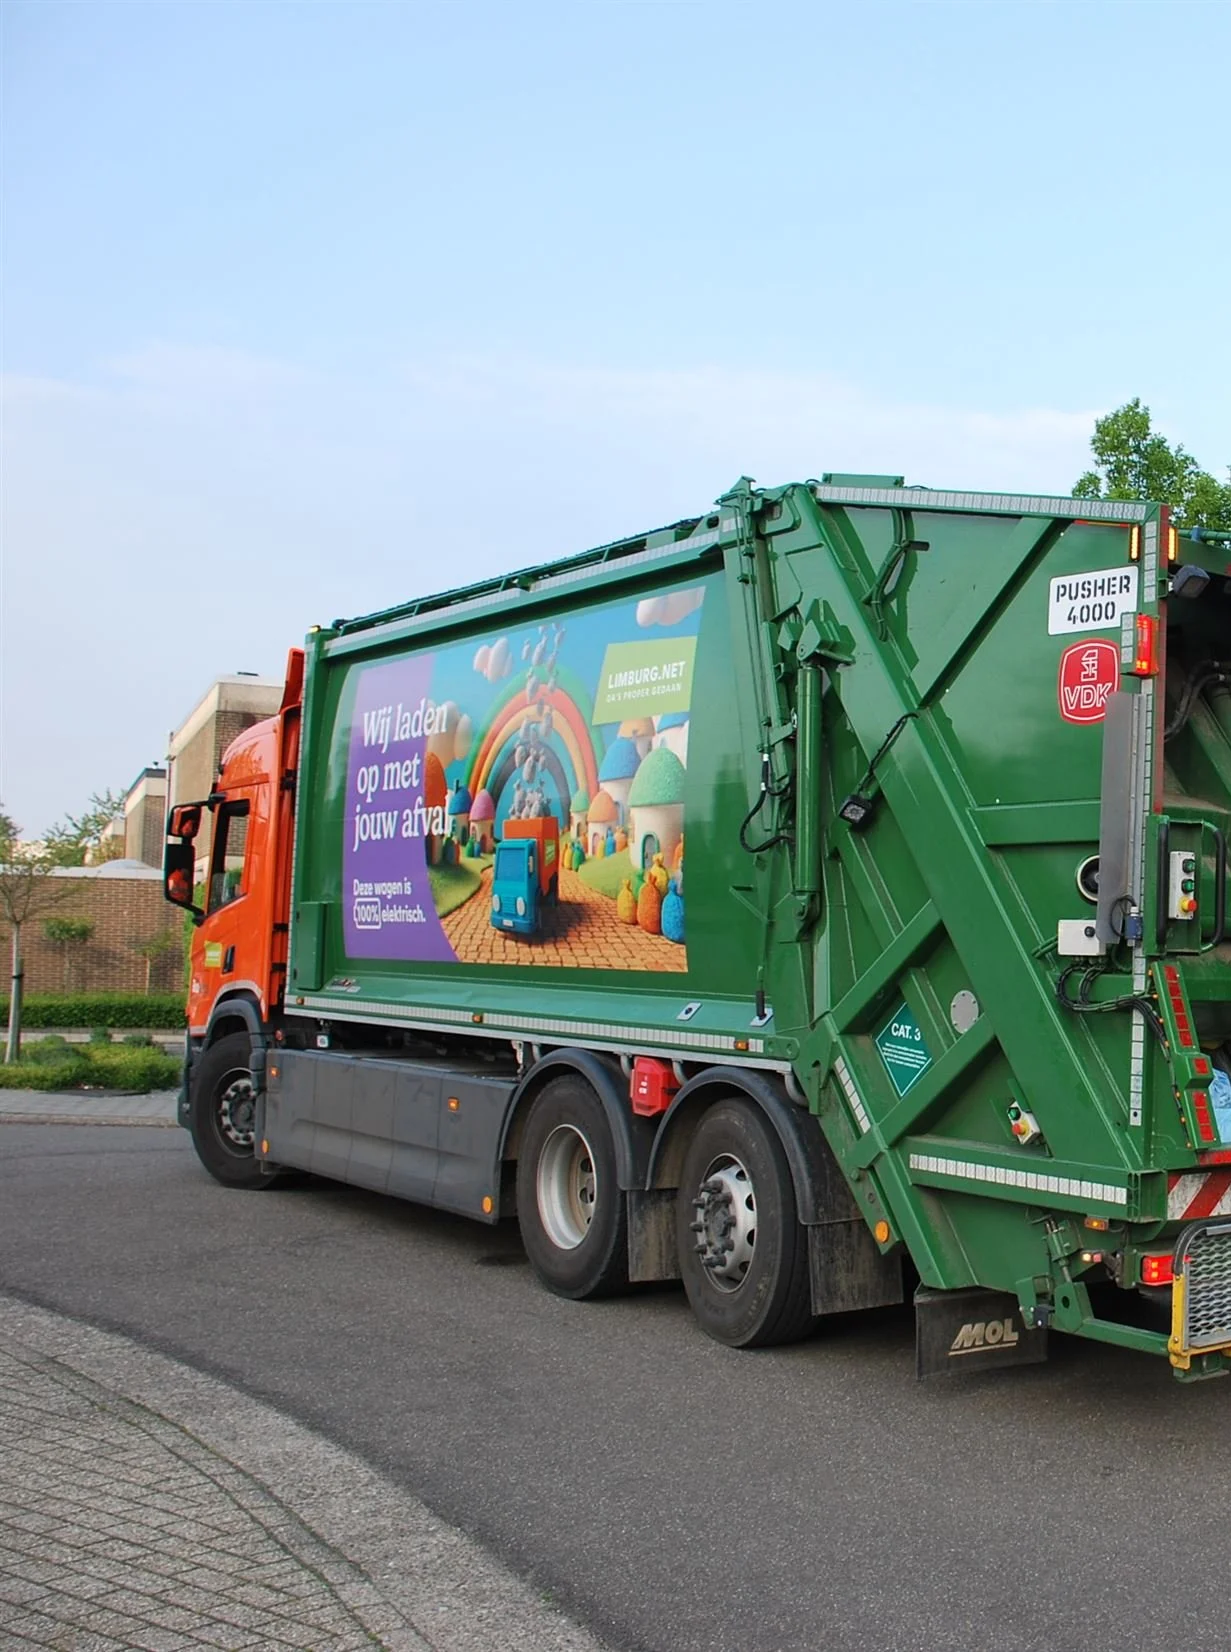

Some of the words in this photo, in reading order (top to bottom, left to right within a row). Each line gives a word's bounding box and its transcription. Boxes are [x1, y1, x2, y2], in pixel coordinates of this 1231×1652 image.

[1056, 574, 1131, 603] PUSHER
[1067, 601, 1116, 625] 4000
[607, 660, 686, 690] LIMBURG.NET
[1064, 682, 1113, 710] VDK
[363, 706, 393, 754] Wij
[393, 697, 448, 742] laden
[357, 765, 379, 803] op
[382, 752, 421, 791] met
[353, 804, 398, 852] jouw
[353, 878, 373, 896] Deze
[403, 876, 412, 895] is
[355, 904, 379, 923] 100%
[891, 1022, 913, 1040] CAT.
[914, 1027, 921, 1042] 3
[951, 1318, 1019, 1350] MOL
